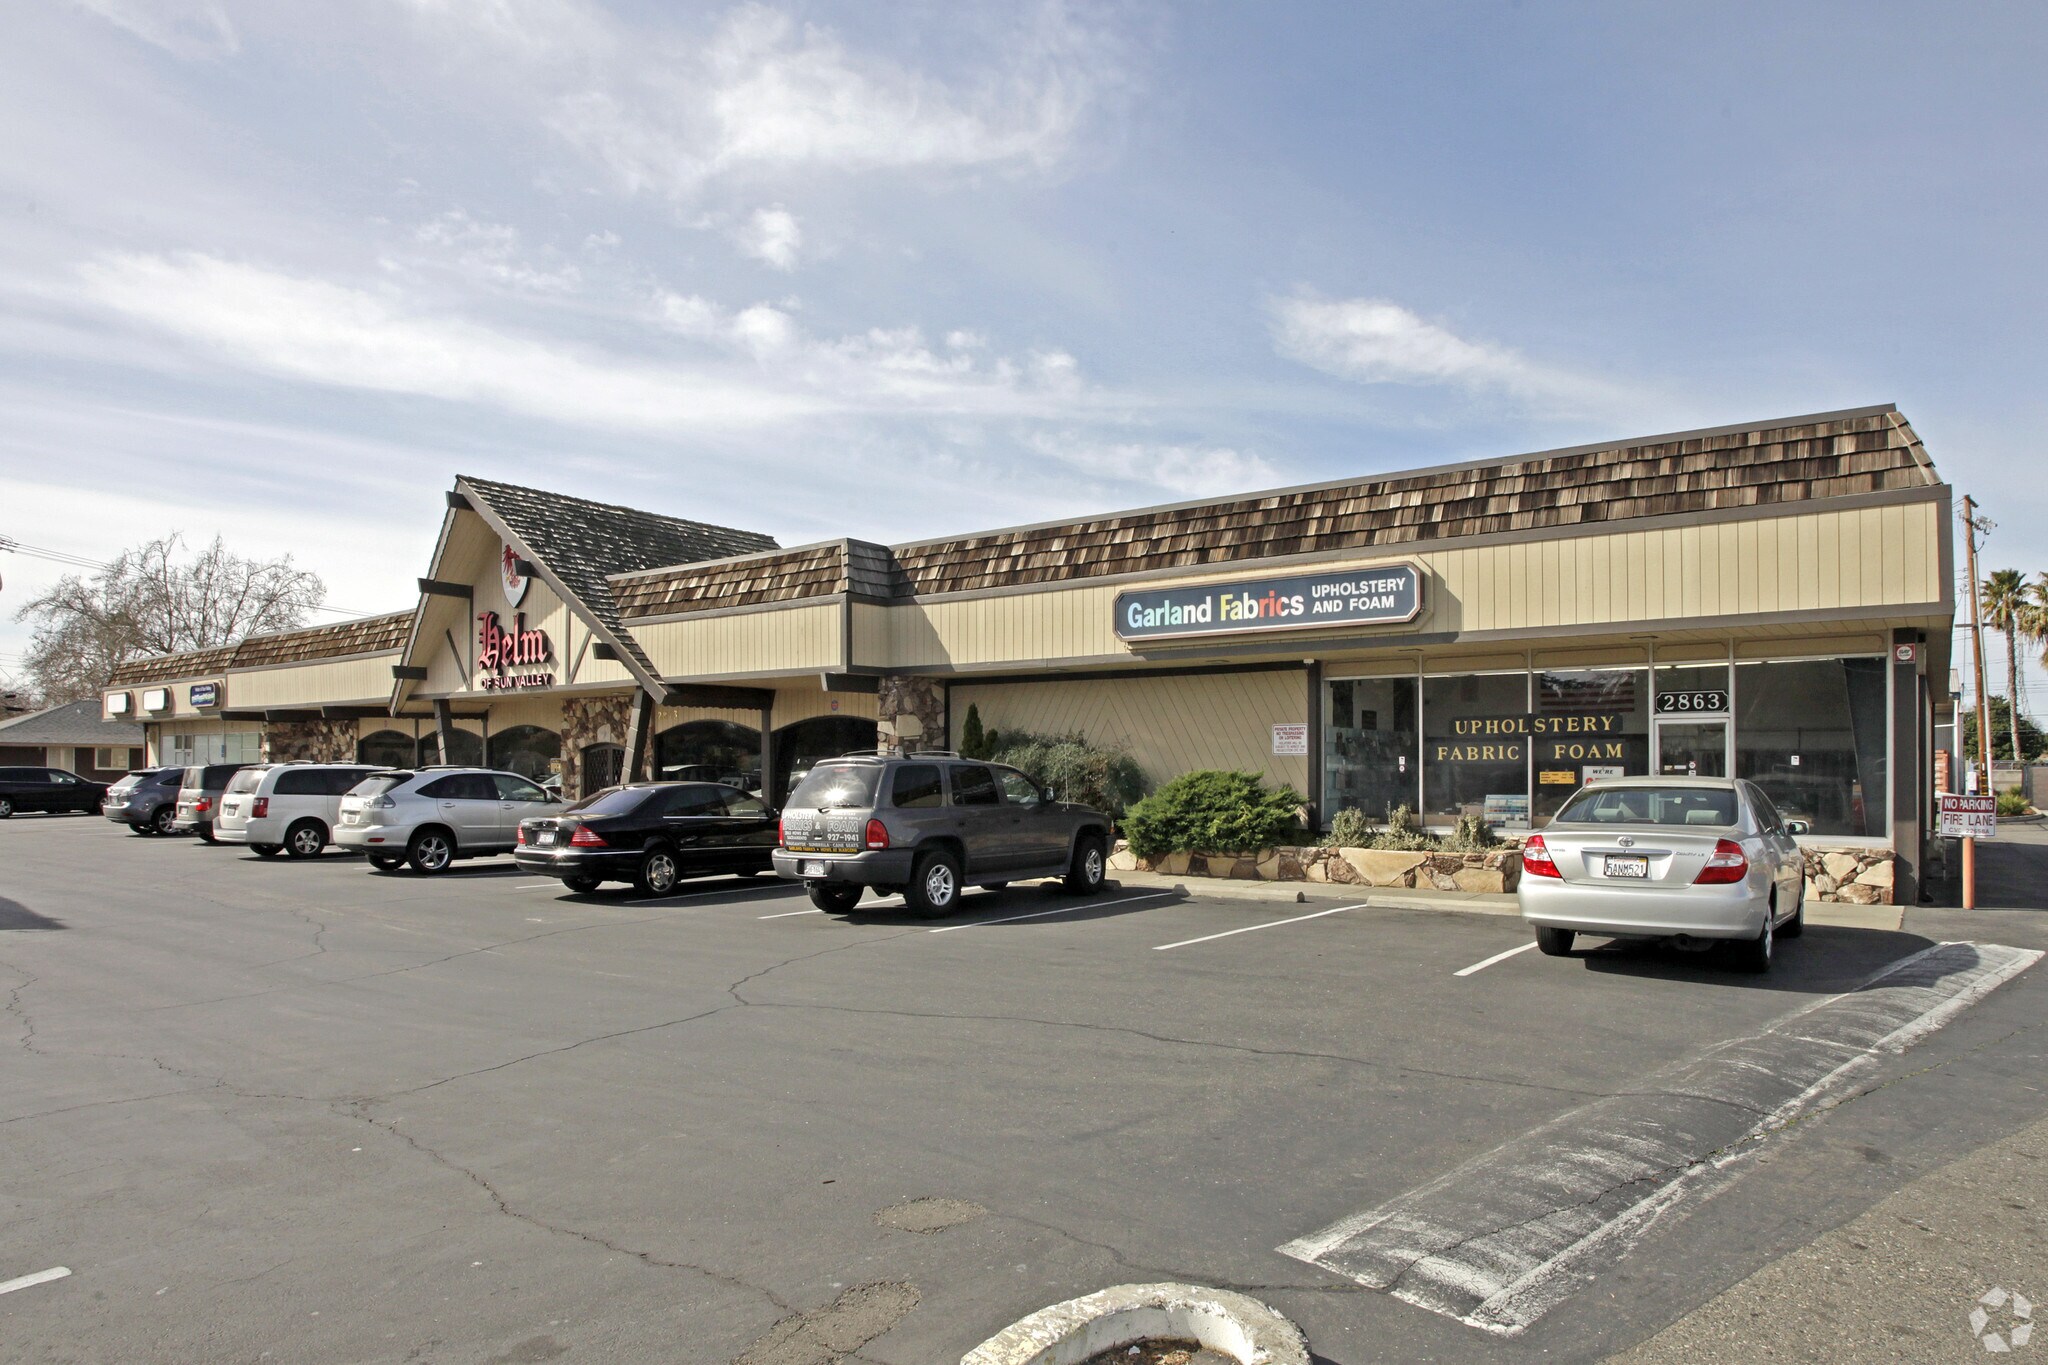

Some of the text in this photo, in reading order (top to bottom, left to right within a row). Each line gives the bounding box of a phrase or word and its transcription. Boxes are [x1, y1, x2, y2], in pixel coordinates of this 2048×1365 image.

[1311, 577, 1406, 598] UPHOLSTERY
[1127, 590, 1304, 628] Garland Fabrics
[1312, 595, 1395, 614] AND FOAM
[477, 611, 548, 676] Helm
[482, 674, 549, 689] OF SUN VALLEY
[1663, 693, 1720, 711] 2863
[1455, 716, 1615, 735] UPHOLSTERY
[1437, 743, 1623, 761] FABRIC FOAM
[1944, 798, 1993, 810] NO PARKING
[827, 821, 858, 832] FOAM
[1944, 814, 1993, 826] FIRE LANE
[827, 834, 859, 842] 927-1941
